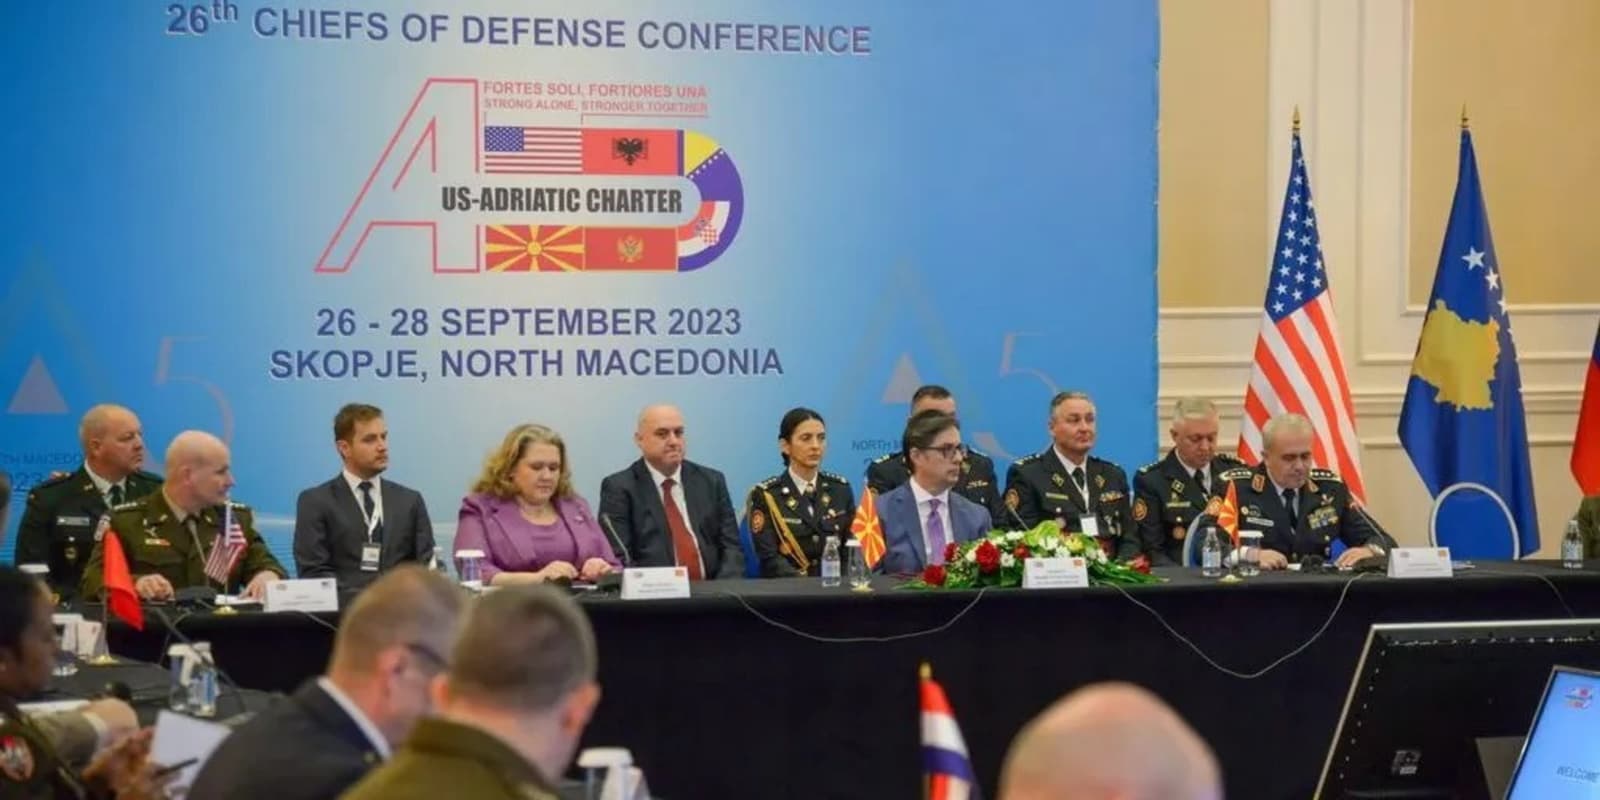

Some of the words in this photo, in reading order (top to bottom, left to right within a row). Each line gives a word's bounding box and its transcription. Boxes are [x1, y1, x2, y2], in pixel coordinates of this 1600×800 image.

[254, 7, 389, 41] CHIEFS
[402, 14, 449, 42] OF
[463, 16, 626, 48] DEFENSE
[638, 21, 872, 53] CONFERENCE
[484, 81, 542, 95] FORTES
[588, 83, 672, 98] FORTIORES
[676, 86, 707, 98] UNA
[484, 99, 533, 110] STRONG
[582, 101, 643, 112] STRONGER
[442, 187, 580, 213] US-ADRIATIC
[586, 189, 682, 214] CHARTER
[317, 308, 356, 336] 26
[391, 308, 429, 336] 28
[441, 308, 657, 336] SEPTEMBER
[668, 308, 742, 335] 2023
[270, 349, 428, 383] SKOPJE,
[441, 349, 564, 377] NORTH
[576, 348, 784, 376] MACEDONIA
